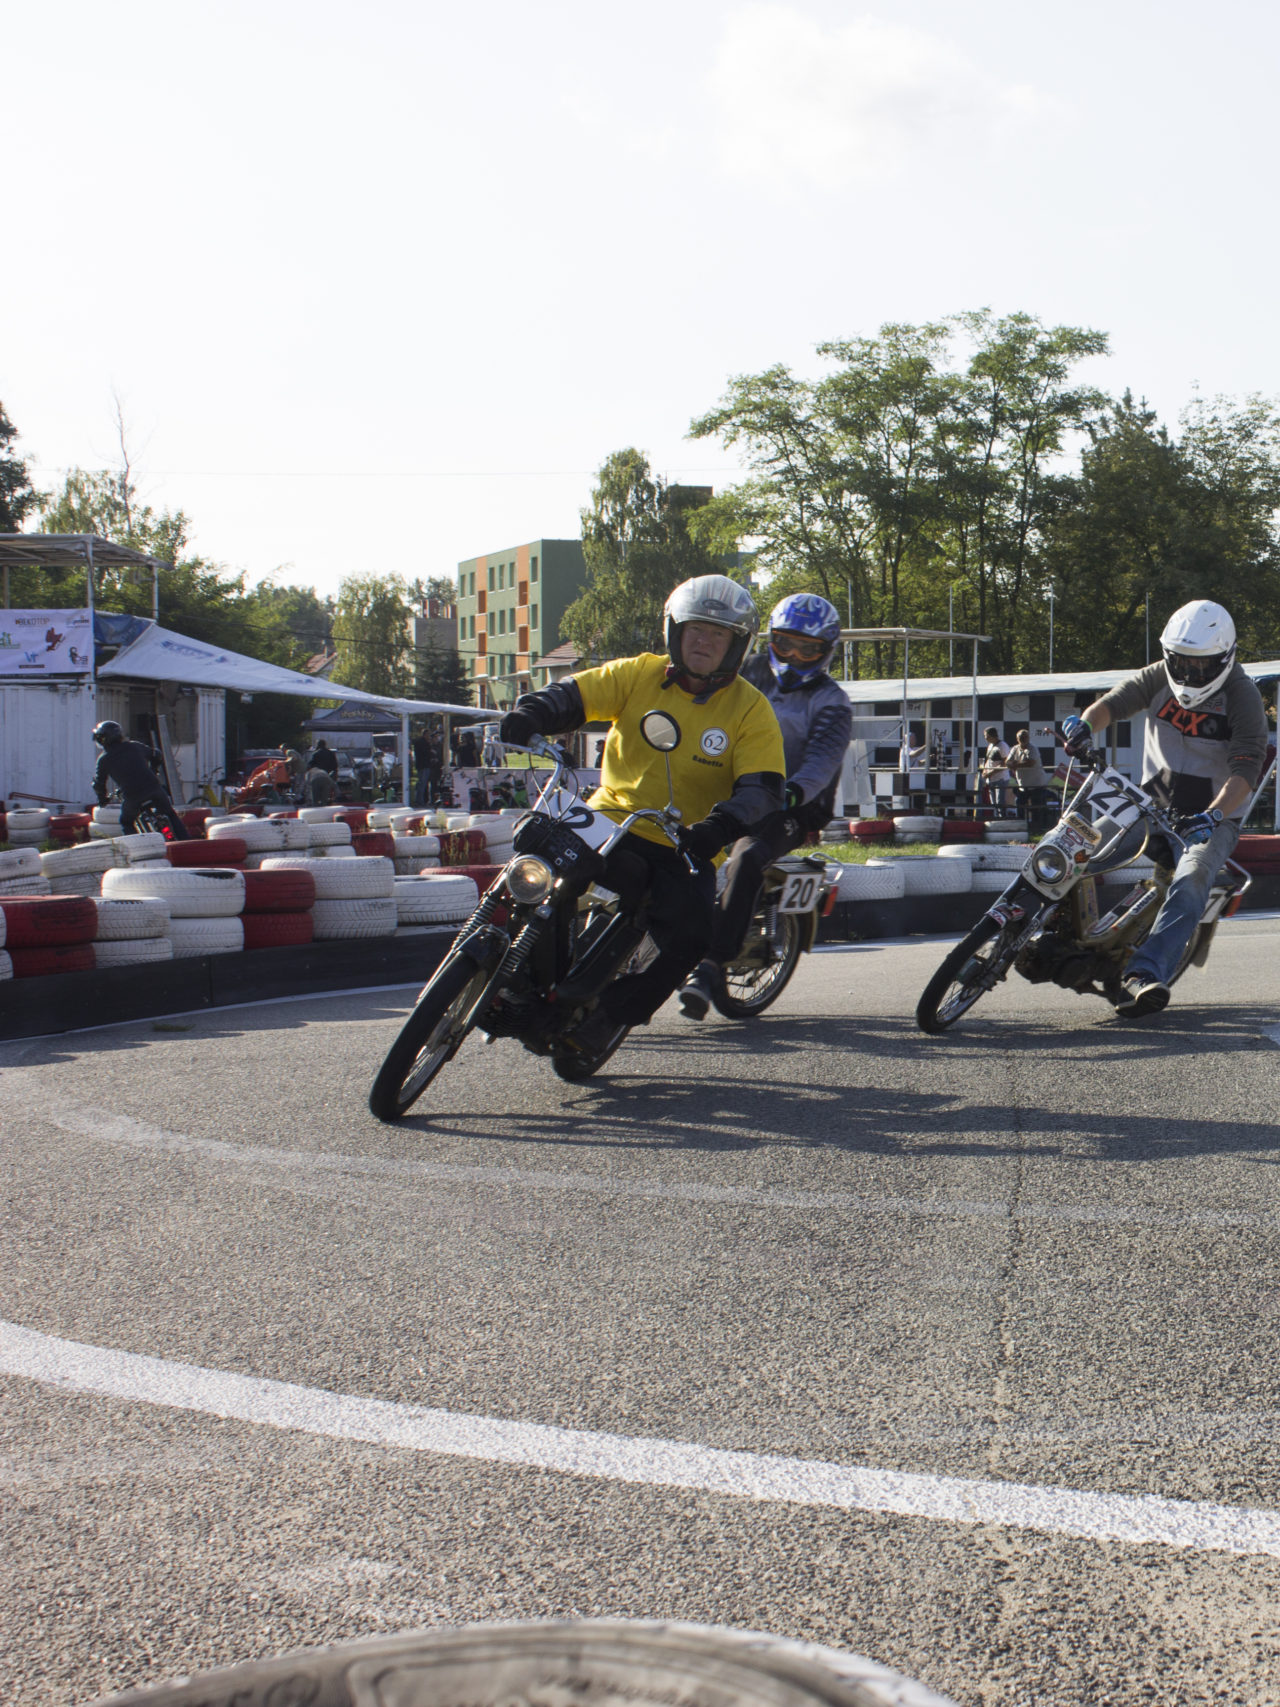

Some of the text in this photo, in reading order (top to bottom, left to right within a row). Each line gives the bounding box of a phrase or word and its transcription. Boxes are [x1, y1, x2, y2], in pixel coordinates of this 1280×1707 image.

[1158, 698, 1208, 736] FOX
[704, 734, 724, 751] 62
[1088, 776, 1145, 818] 27
[783, 878, 815, 909] 20
